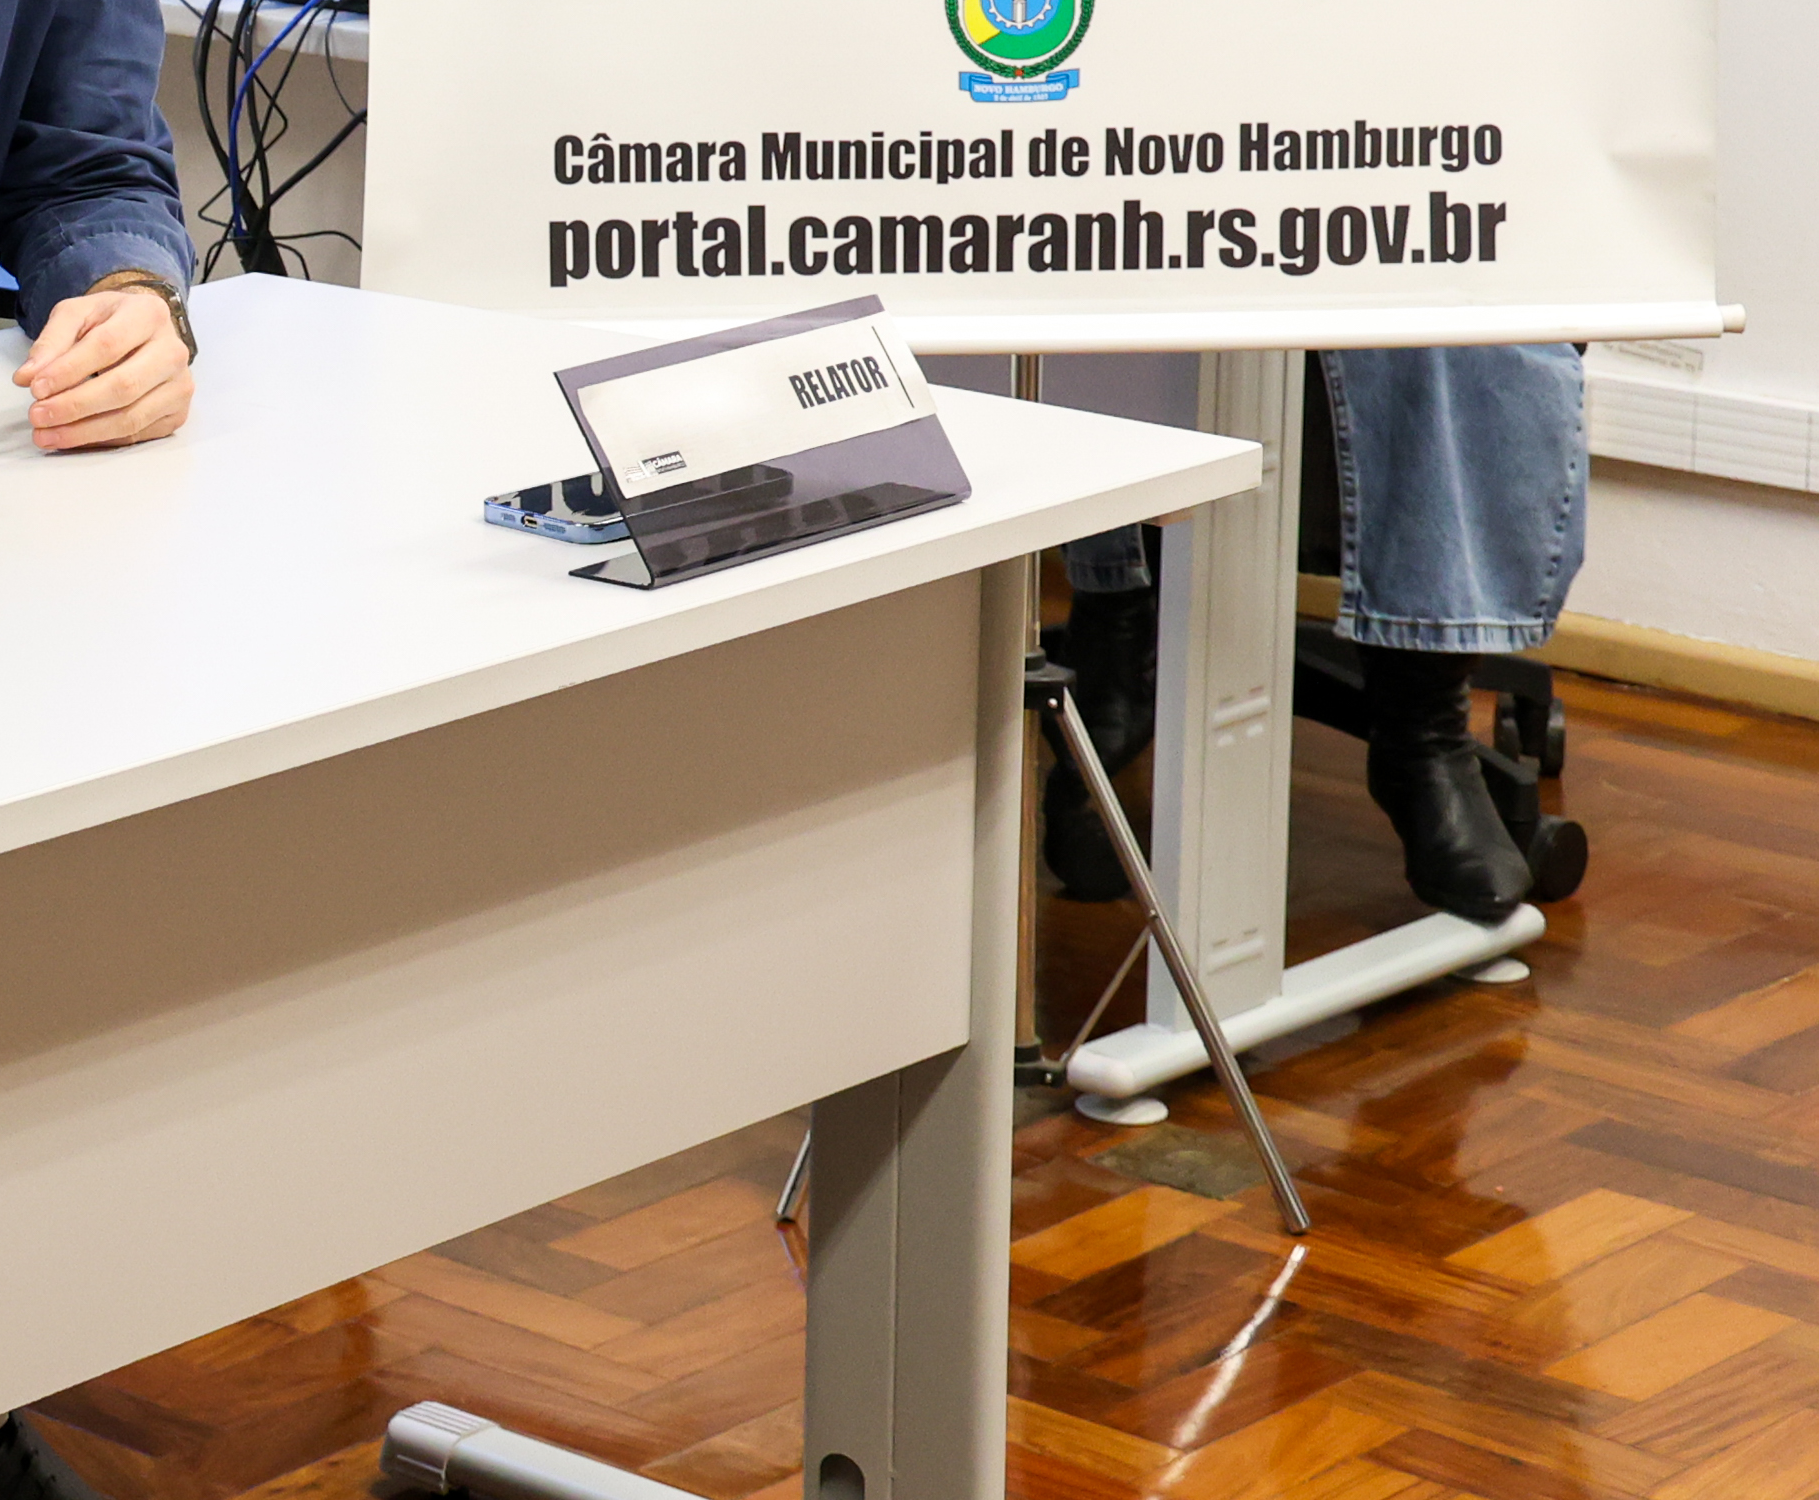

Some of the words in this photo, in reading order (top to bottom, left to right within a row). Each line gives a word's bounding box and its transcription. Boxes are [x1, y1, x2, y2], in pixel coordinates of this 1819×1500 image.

[554, 133, 746, 185] Câmara
[762, 129, 1012, 184] Municipal
[1029, 129, 1089, 177] de
[1106, 127, 1223, 176] Novo
[1240, 120, 1502, 172] Hamburgo
[549, 191, 1506, 287] portal.camaranh.rs.gov.br
[788, 356, 888, 409] RELATOR
